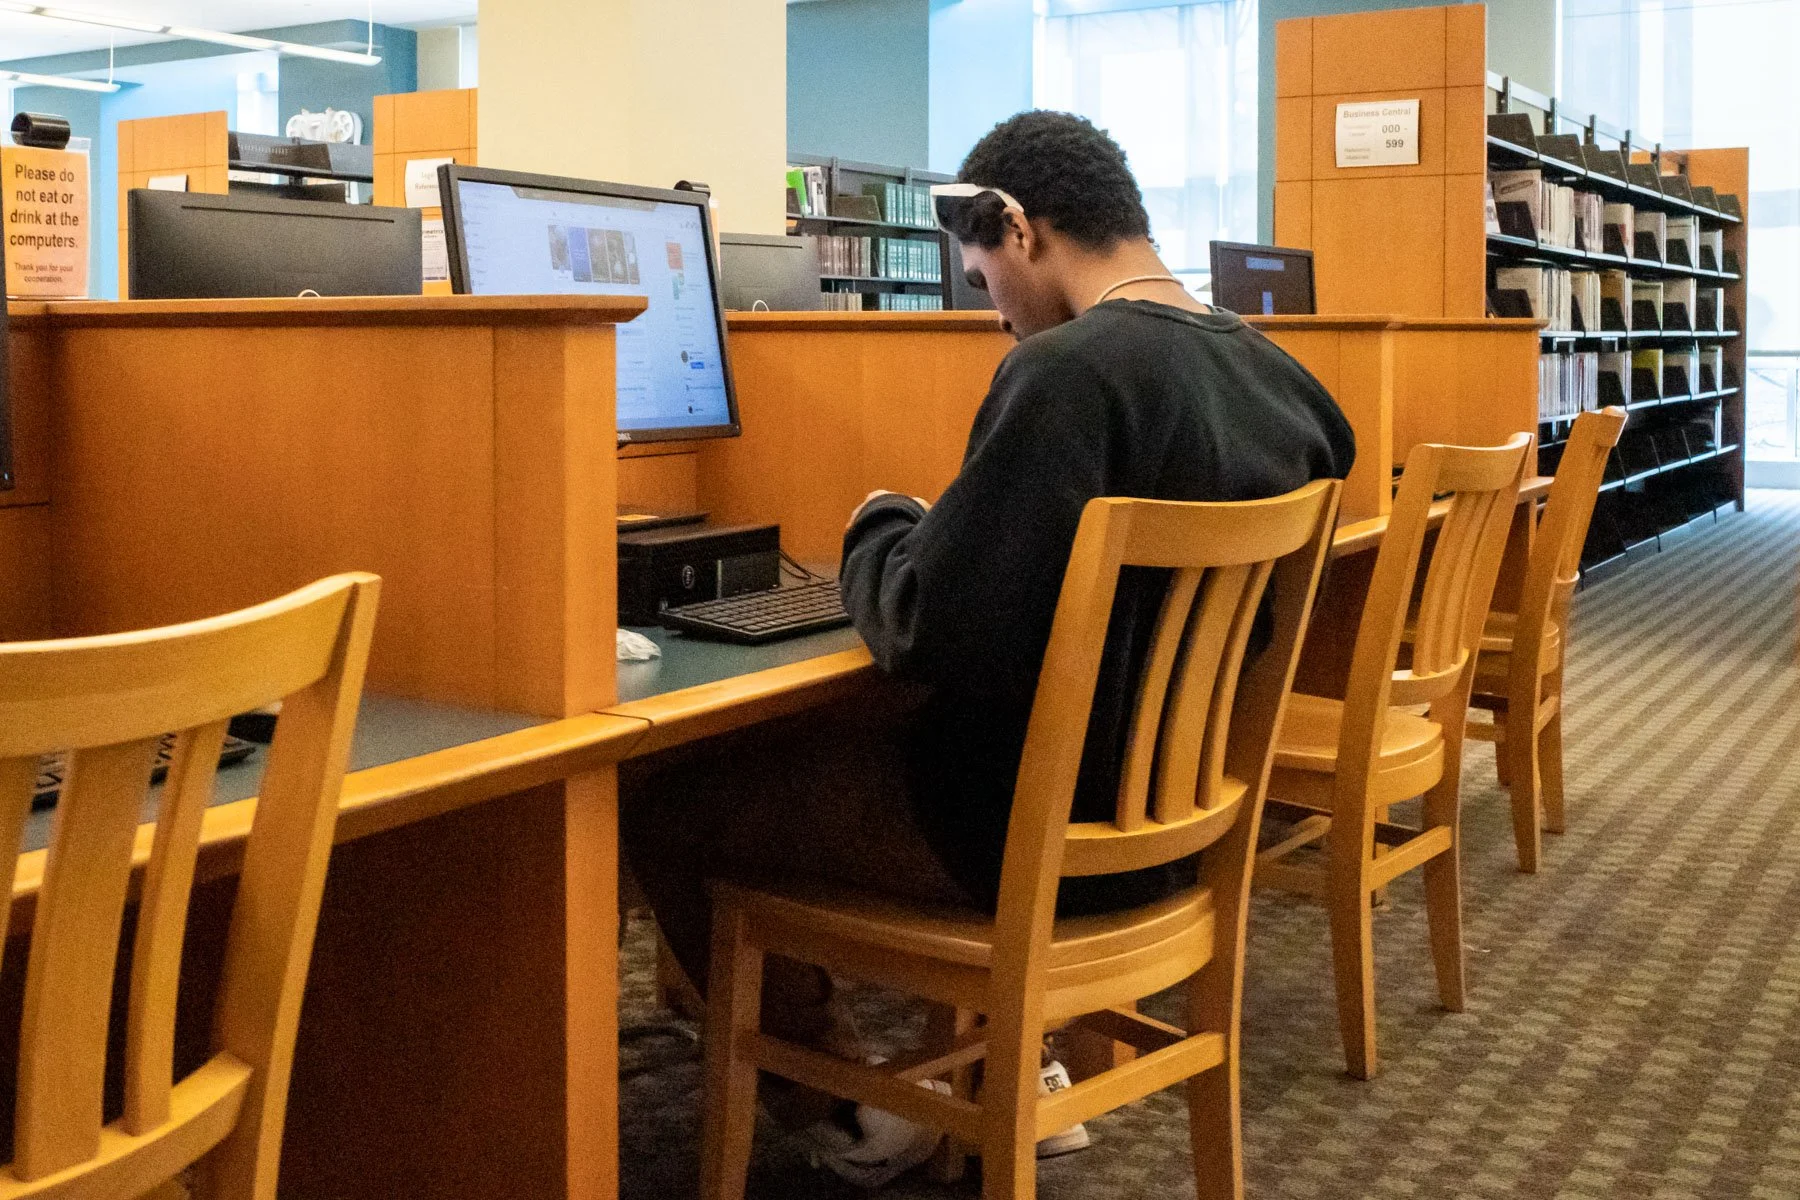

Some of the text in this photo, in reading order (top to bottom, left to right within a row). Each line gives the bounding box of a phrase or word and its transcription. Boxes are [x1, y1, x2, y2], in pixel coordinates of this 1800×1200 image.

[1343, 107, 1411, 119] Business Central
[1381, 124, 1401, 134] 000
[1385, 139, 1404, 148] 599
[15, 163, 75, 183] Please do
[16, 189, 75, 204] not eat or
[10, 209, 79, 226] drink at the
[10, 234, 78, 250] computers.
[14, 262, 34, 271] Thank
[35, 264, 48, 273] you
[48, 262, 59, 272] for
